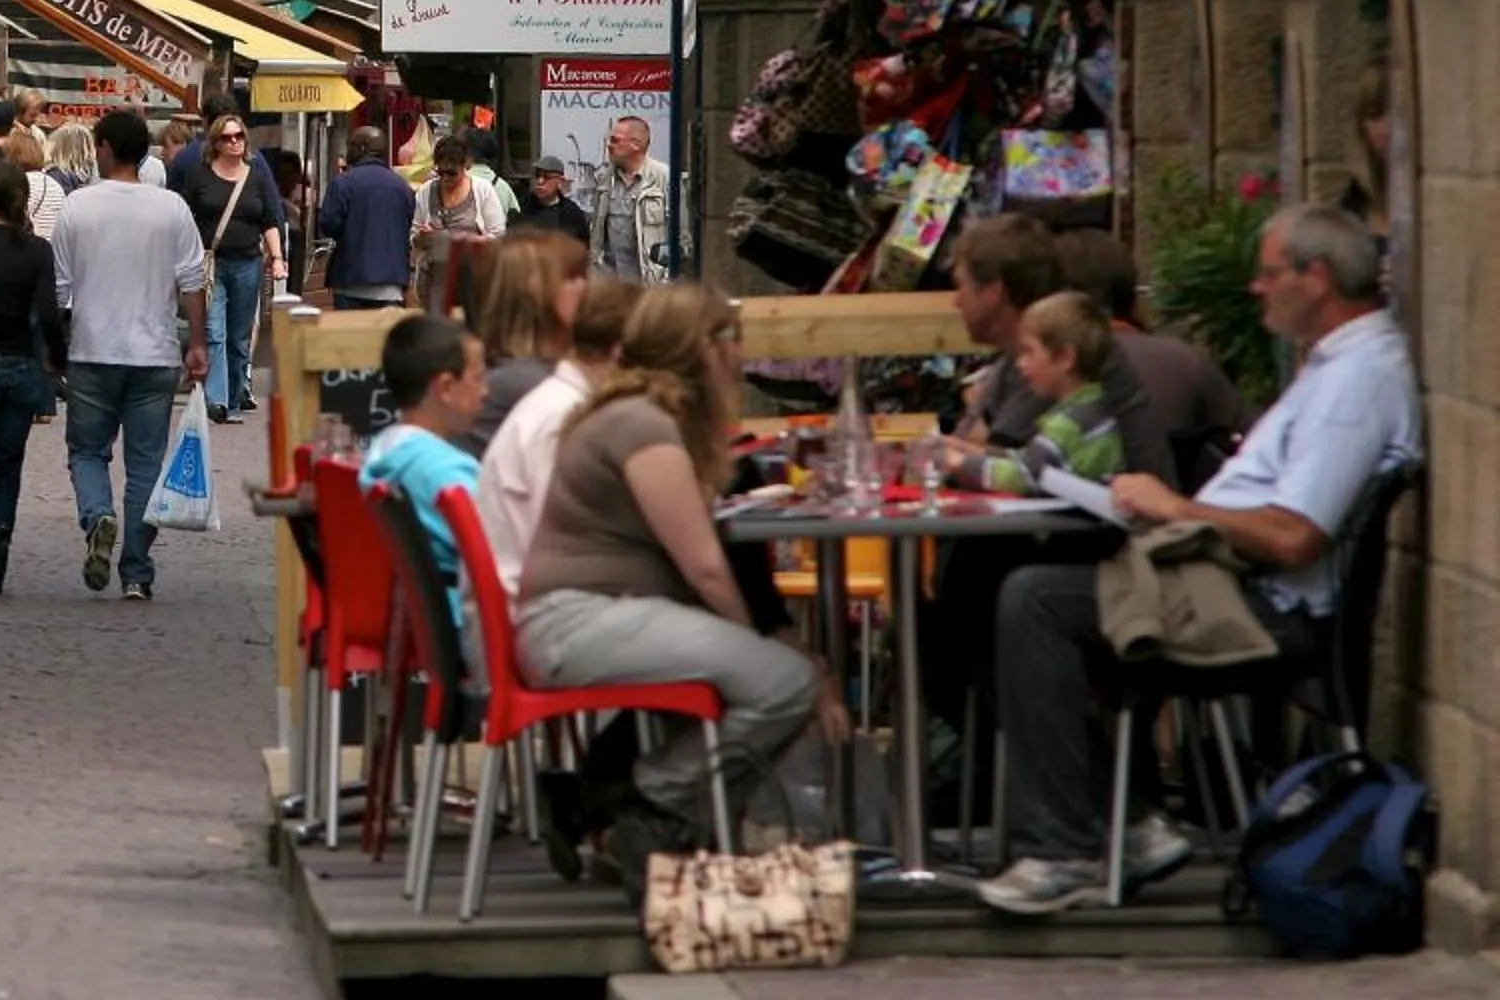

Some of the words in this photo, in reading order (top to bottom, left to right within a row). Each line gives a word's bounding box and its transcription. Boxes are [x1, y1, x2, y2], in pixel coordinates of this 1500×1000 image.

[106, 13, 133, 41] de
[131, 26, 194, 80] MER
[547, 63, 617, 83] Macarons
